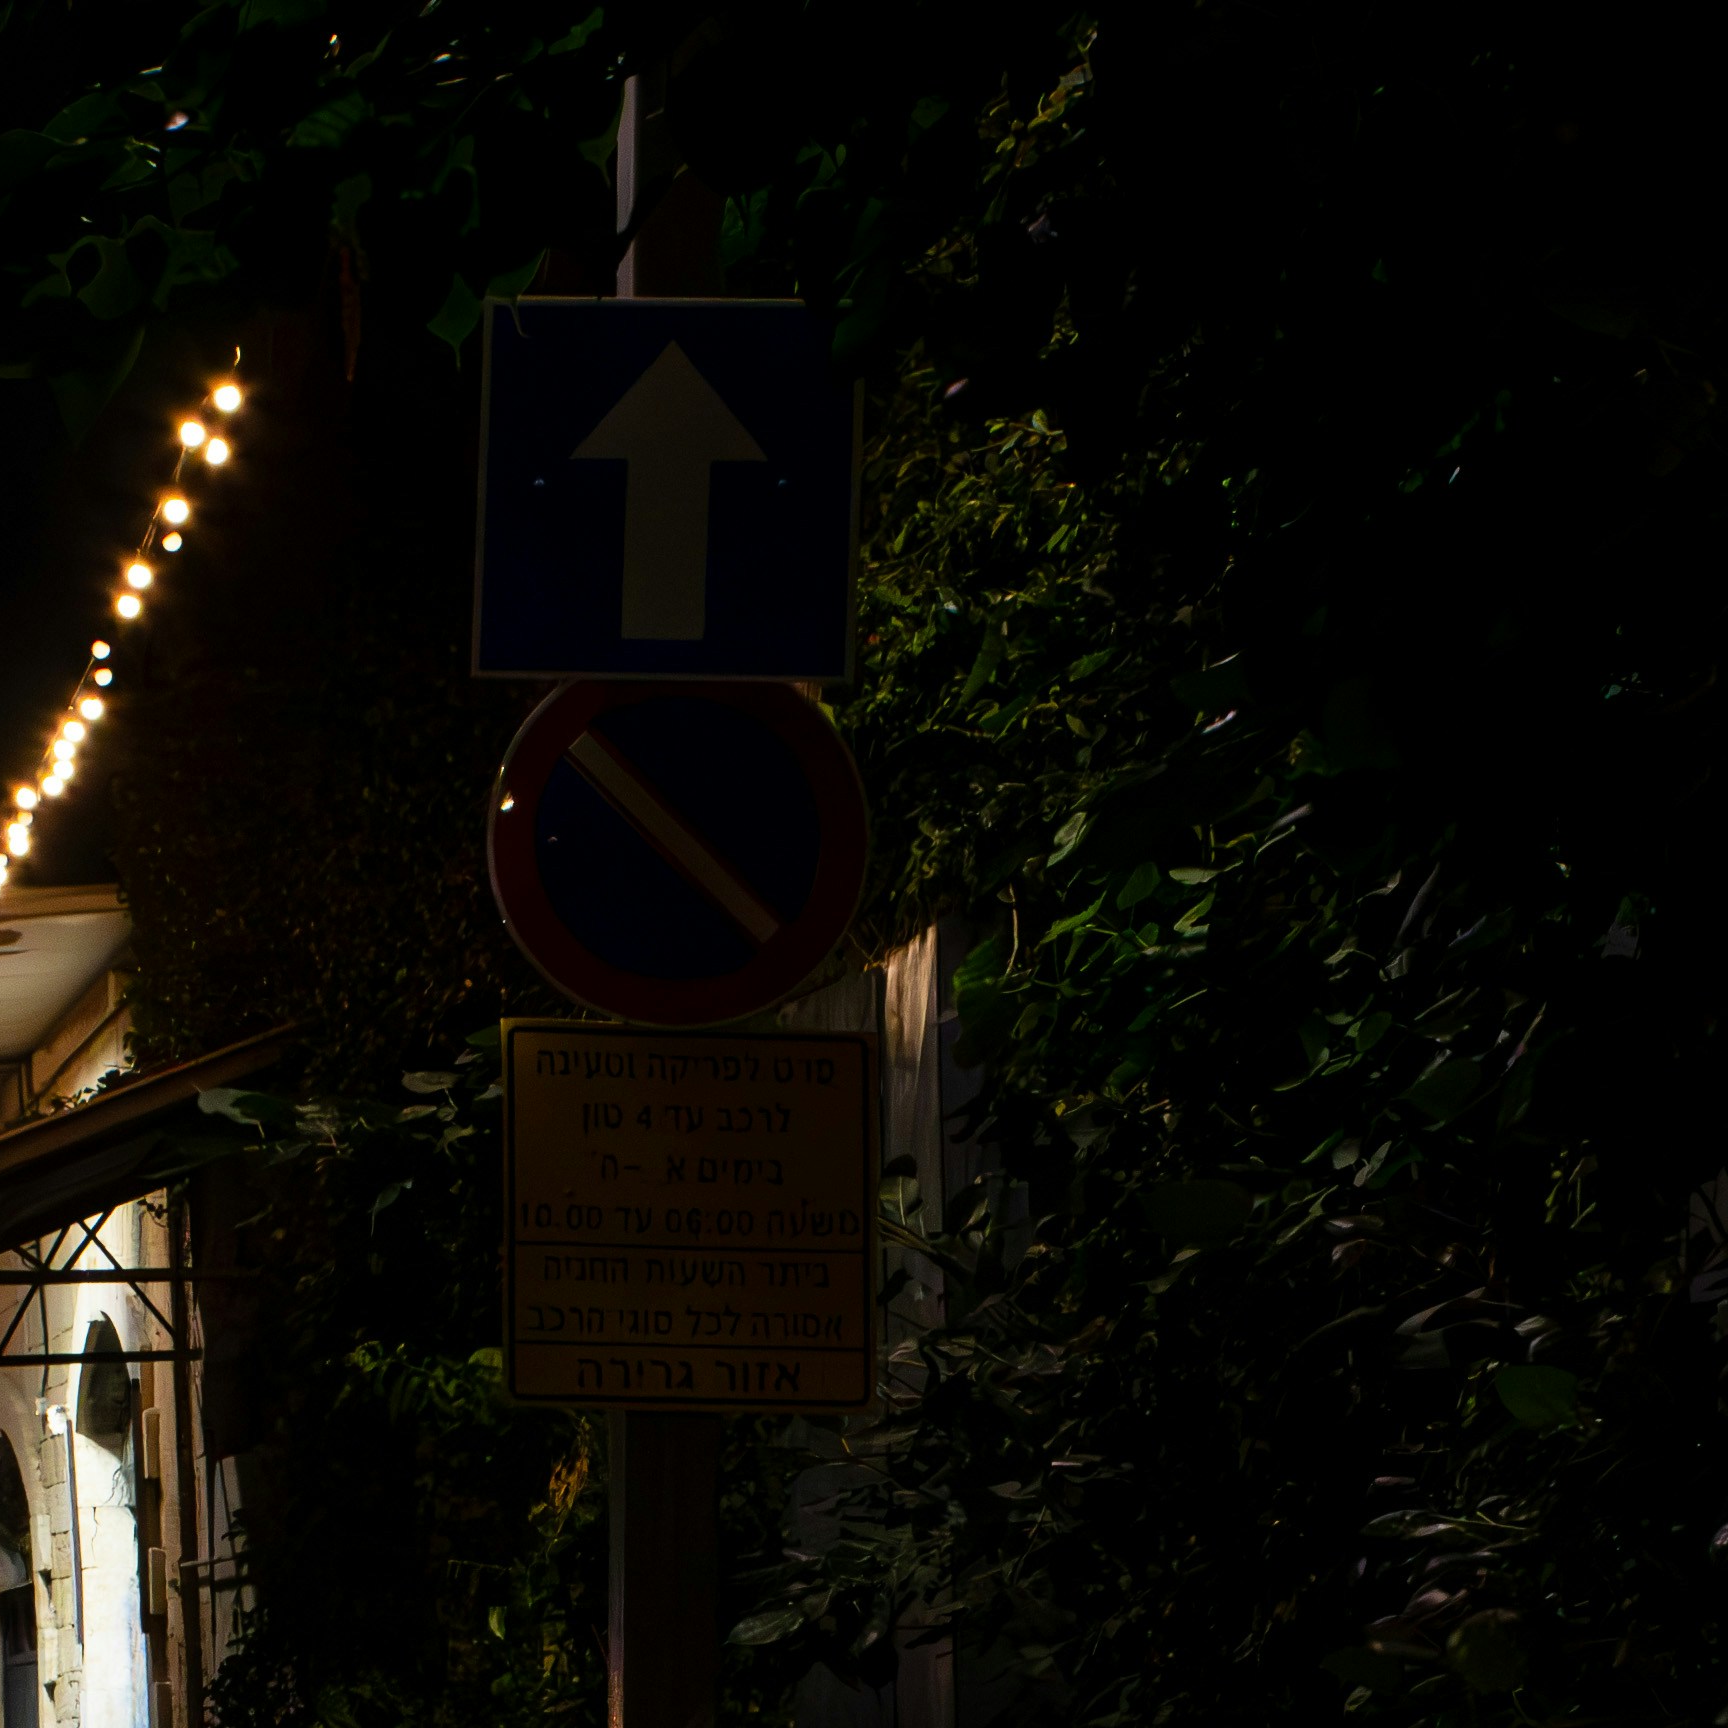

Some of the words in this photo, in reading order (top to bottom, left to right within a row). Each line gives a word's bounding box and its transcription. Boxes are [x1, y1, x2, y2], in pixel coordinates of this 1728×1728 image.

[536, 1049, 637, 1080] וטעינה
[647, 1051, 760, 1085] לפריקה
[582, 1102, 624, 1134] טון
[636, 1103, 653, 1130] 4
[664, 1105, 704, 1133] עד
[716, 1102, 792, 1134] לרכב
[698, 1156, 784, 1186] בימים
[615, 1206, 653, 1235] עד
[665, 1207, 755, 1240] 06:00
[543, 1255, 629, 1284] החניה
[644, 1256, 746, 1289] השעות
[758, 1260, 831, 1289] ביתר
[524, 1305, 605, 1334] הרכב
[618, 1309, 673, 1336] סוגי
[685, 1305, 741, 1338] לכל
[750, 1311, 844, 1341] אסורה
[576, 1357, 694, 1391] גרירה
[715, 1359, 802, 1393] אזור
